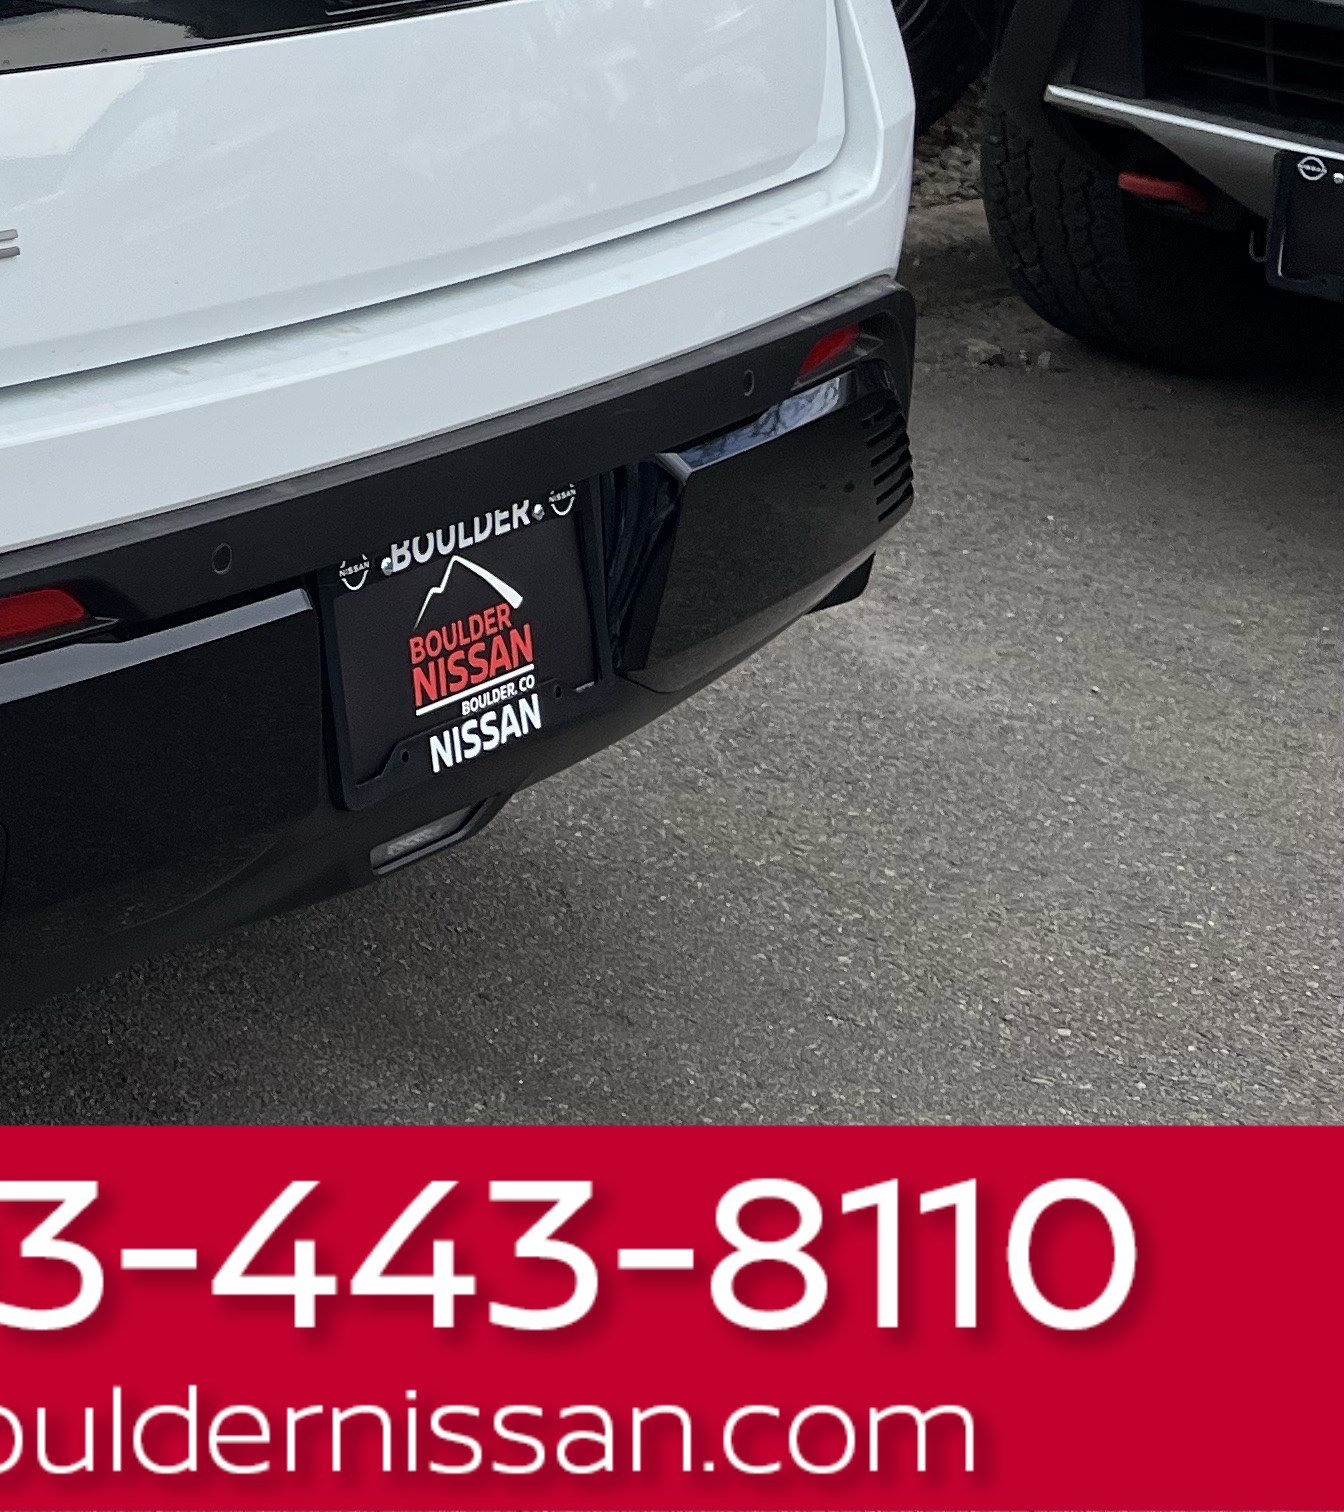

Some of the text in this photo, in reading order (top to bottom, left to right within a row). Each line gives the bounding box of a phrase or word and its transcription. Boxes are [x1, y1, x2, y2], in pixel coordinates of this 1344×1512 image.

[409, 603, 512, 665] BOULDER
[413, 623, 534, 707] NISSAN
[518, 674, 535, 692] CO
[429, 693, 542, 774] NISSAN
